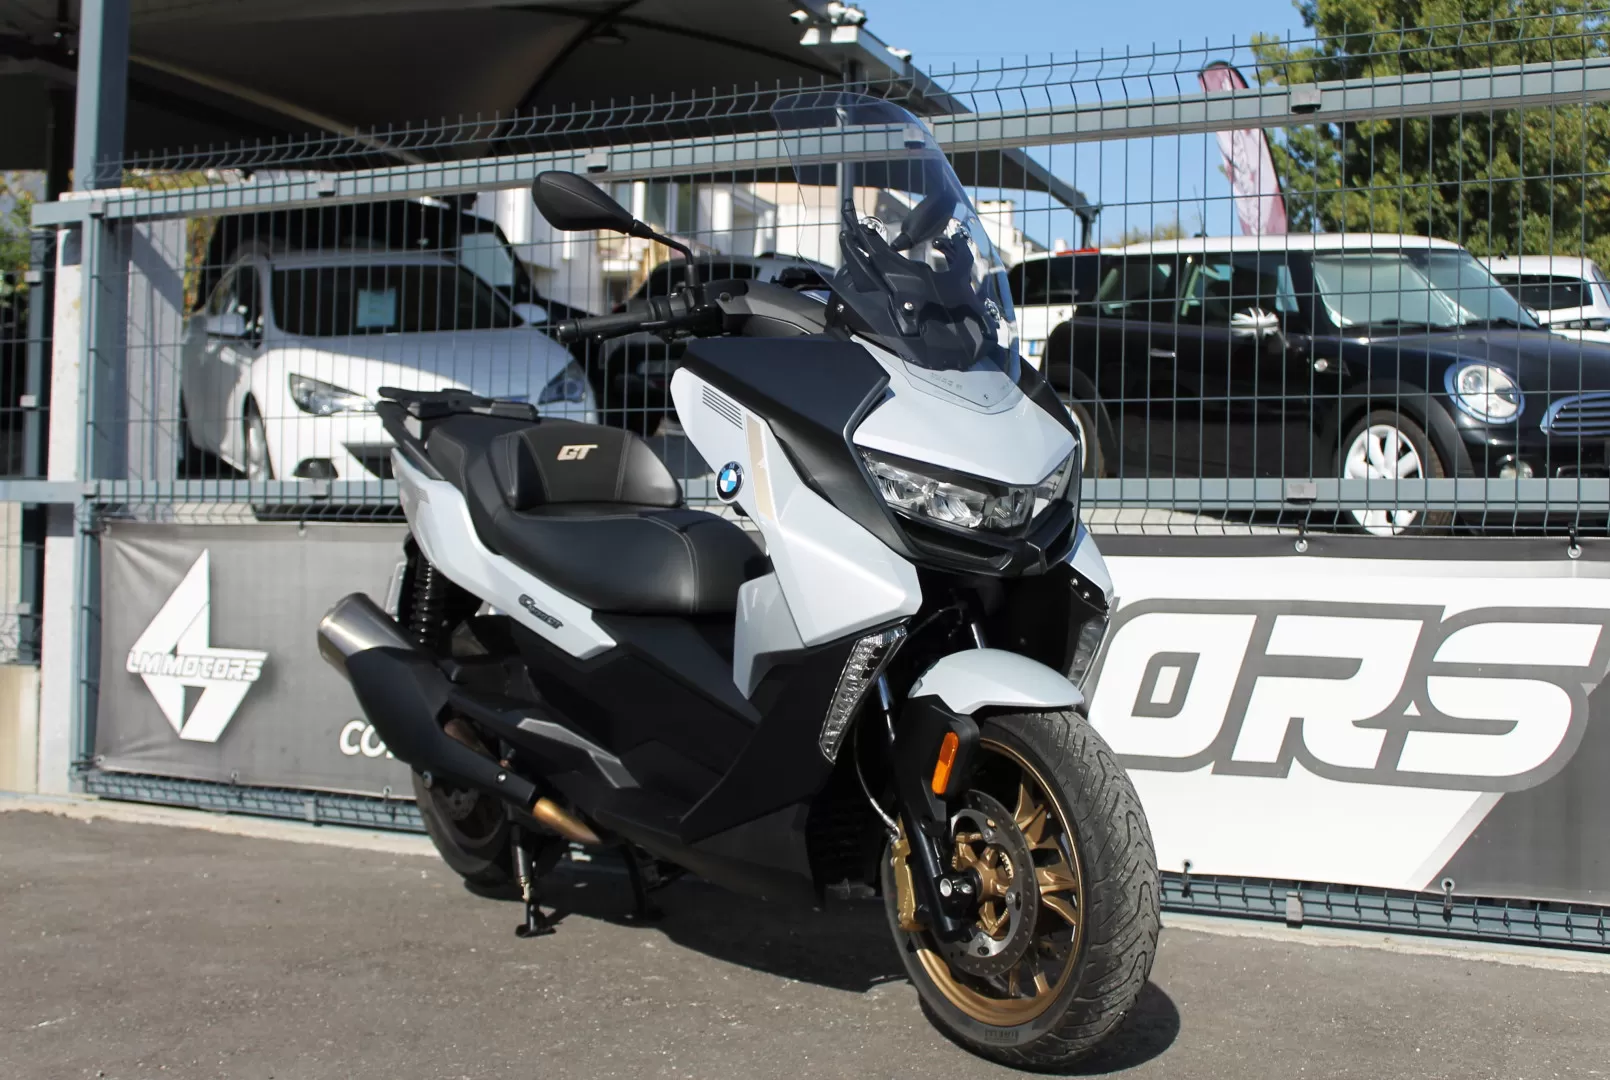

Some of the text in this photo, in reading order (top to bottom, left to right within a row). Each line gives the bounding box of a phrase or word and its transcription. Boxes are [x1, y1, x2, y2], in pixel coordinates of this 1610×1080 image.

[557, 444, 598, 460] GT
[1086, 610, 1604, 779] ORS
[340, 720, 394, 758] CO
